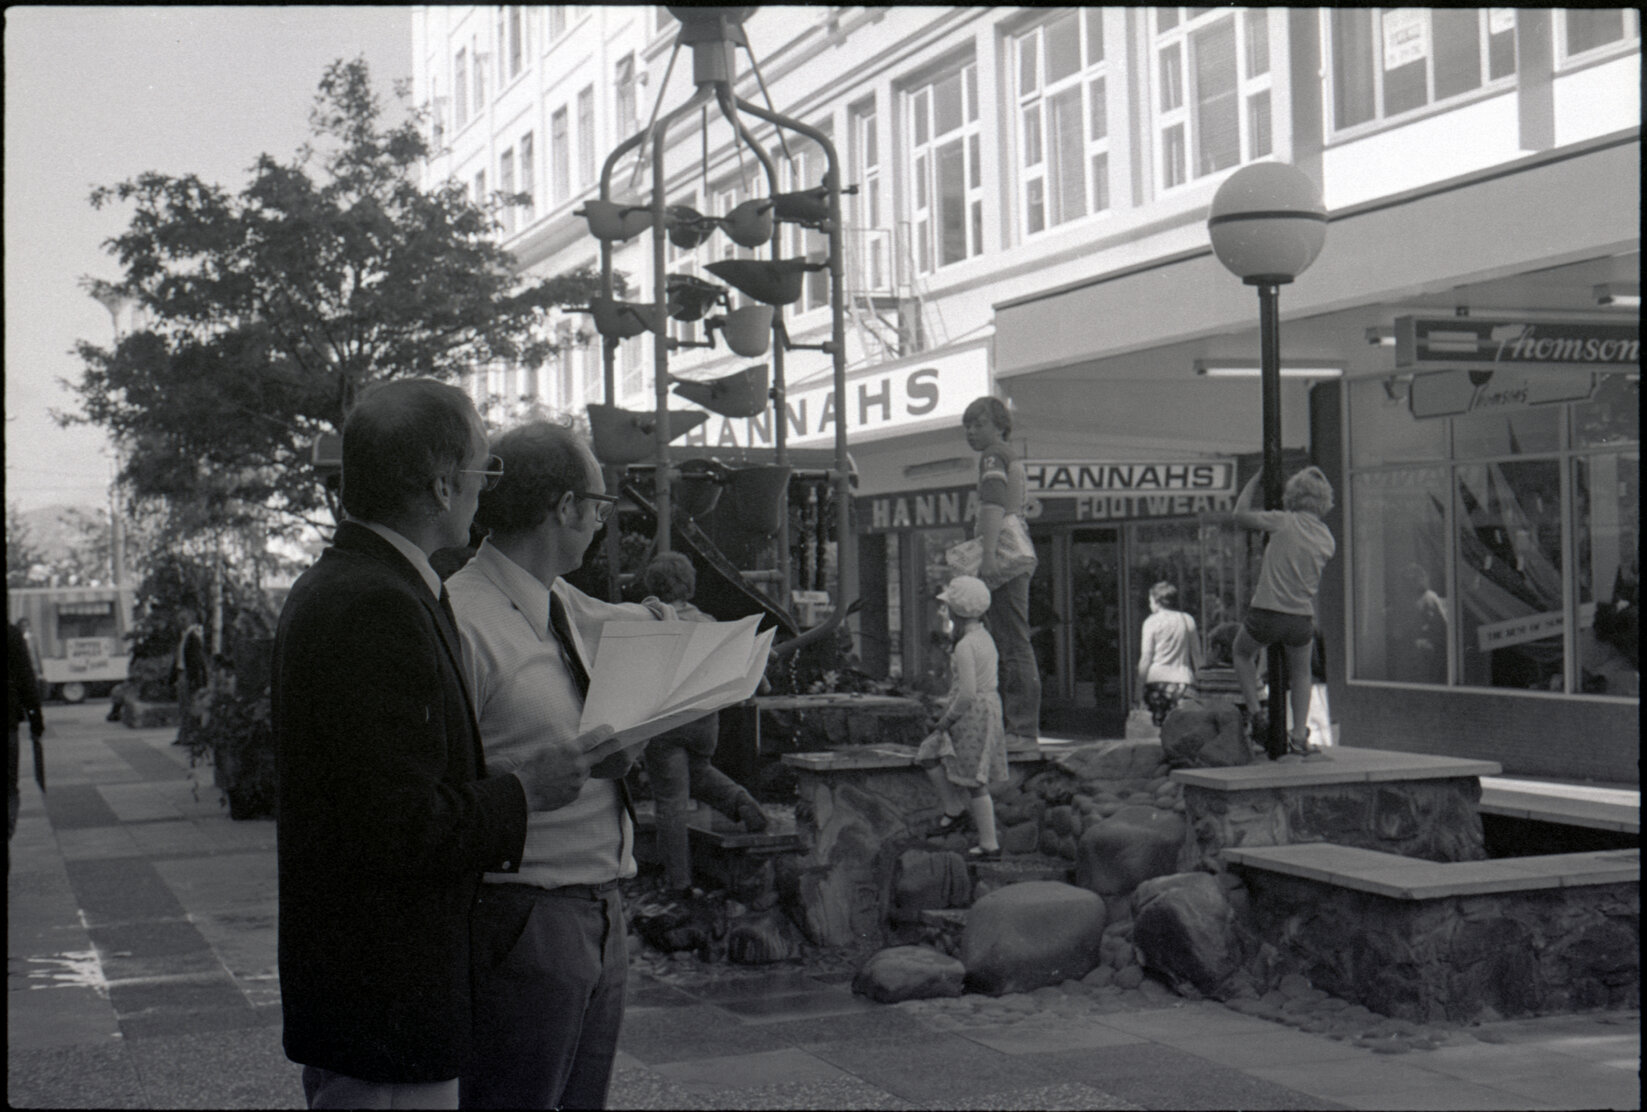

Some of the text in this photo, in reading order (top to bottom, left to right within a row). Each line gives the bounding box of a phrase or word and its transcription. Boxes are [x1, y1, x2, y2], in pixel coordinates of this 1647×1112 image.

[684, 368, 939, 447] HANNAHS
[983, 456, 996, 470] 12
[1027, 466, 1213, 488] HANNAHS
